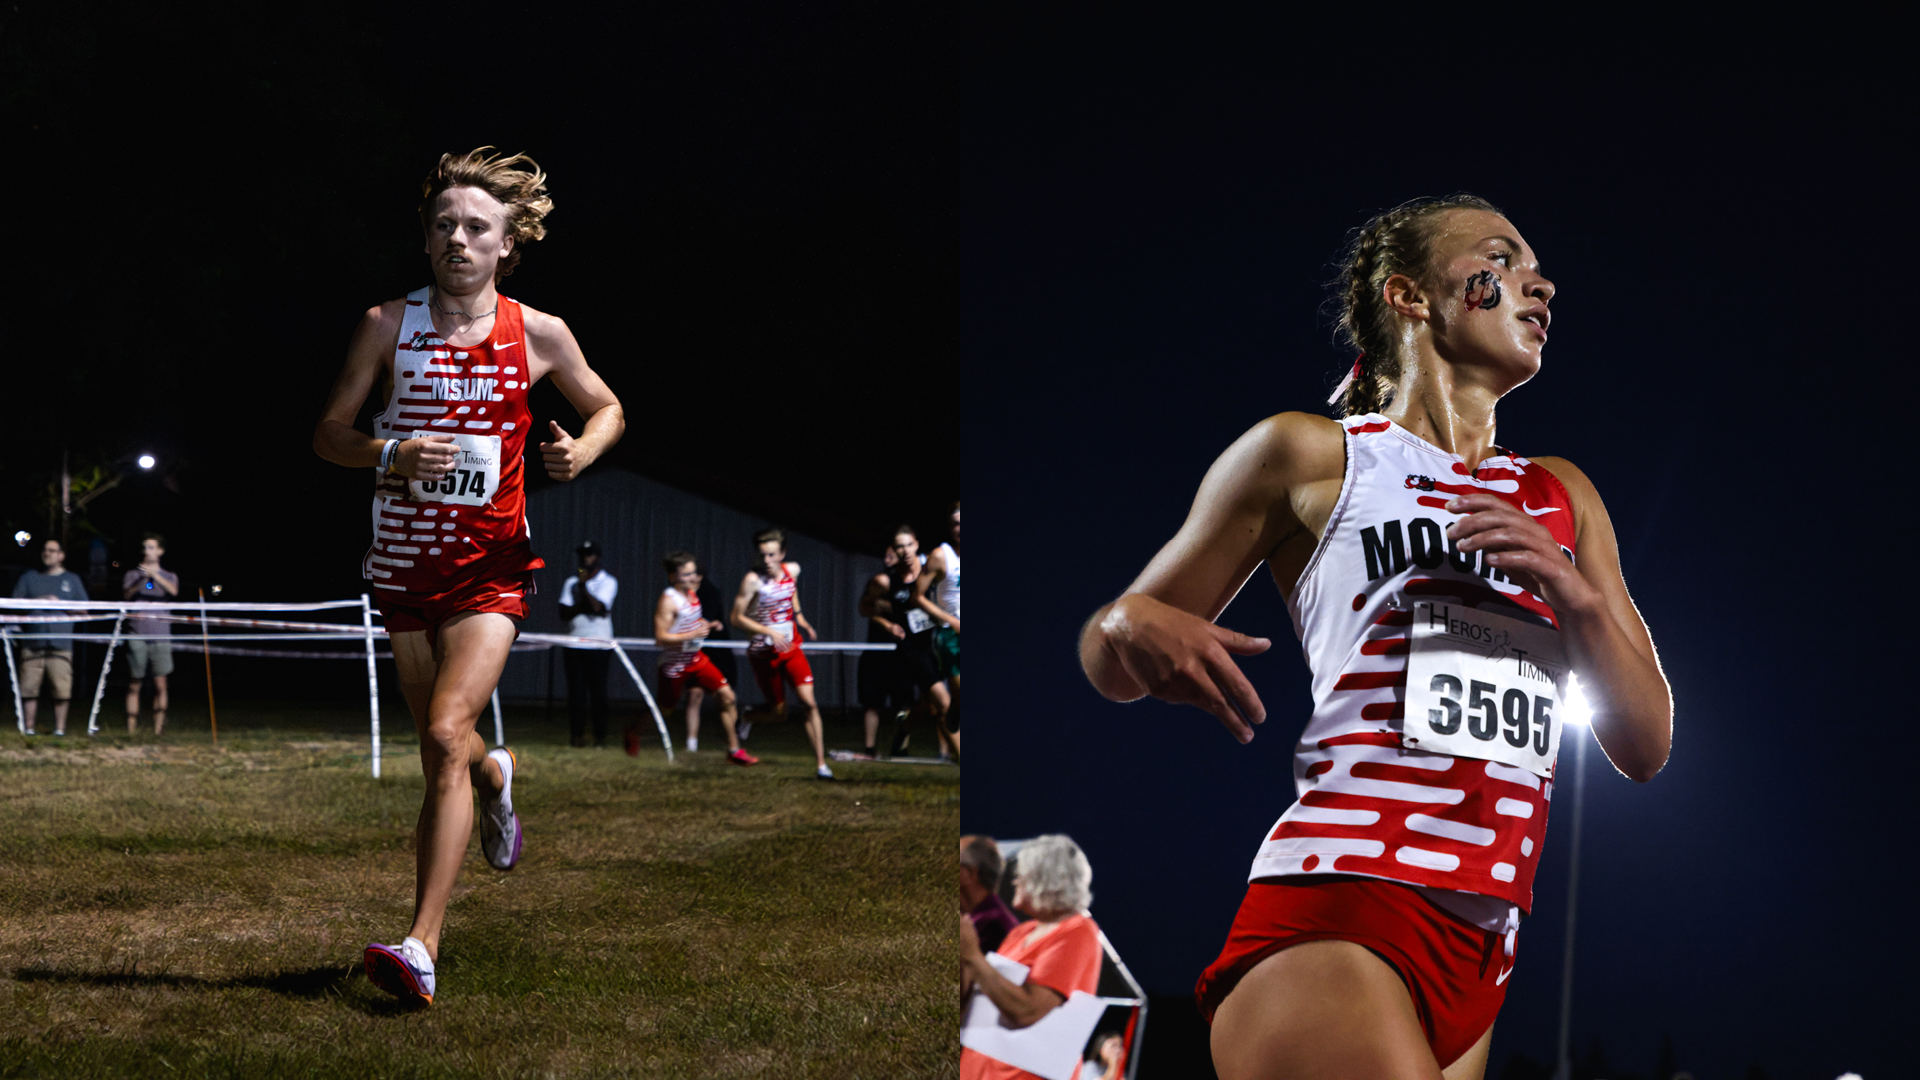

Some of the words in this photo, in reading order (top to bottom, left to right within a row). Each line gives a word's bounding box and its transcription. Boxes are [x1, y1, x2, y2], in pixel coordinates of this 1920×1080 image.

[432, 377, 494, 401] MSUM
[462, 450, 492, 466] TIMING
[1429, 602, 1493, 643] HERO'S
[1428, 673, 1554, 757] 3595
